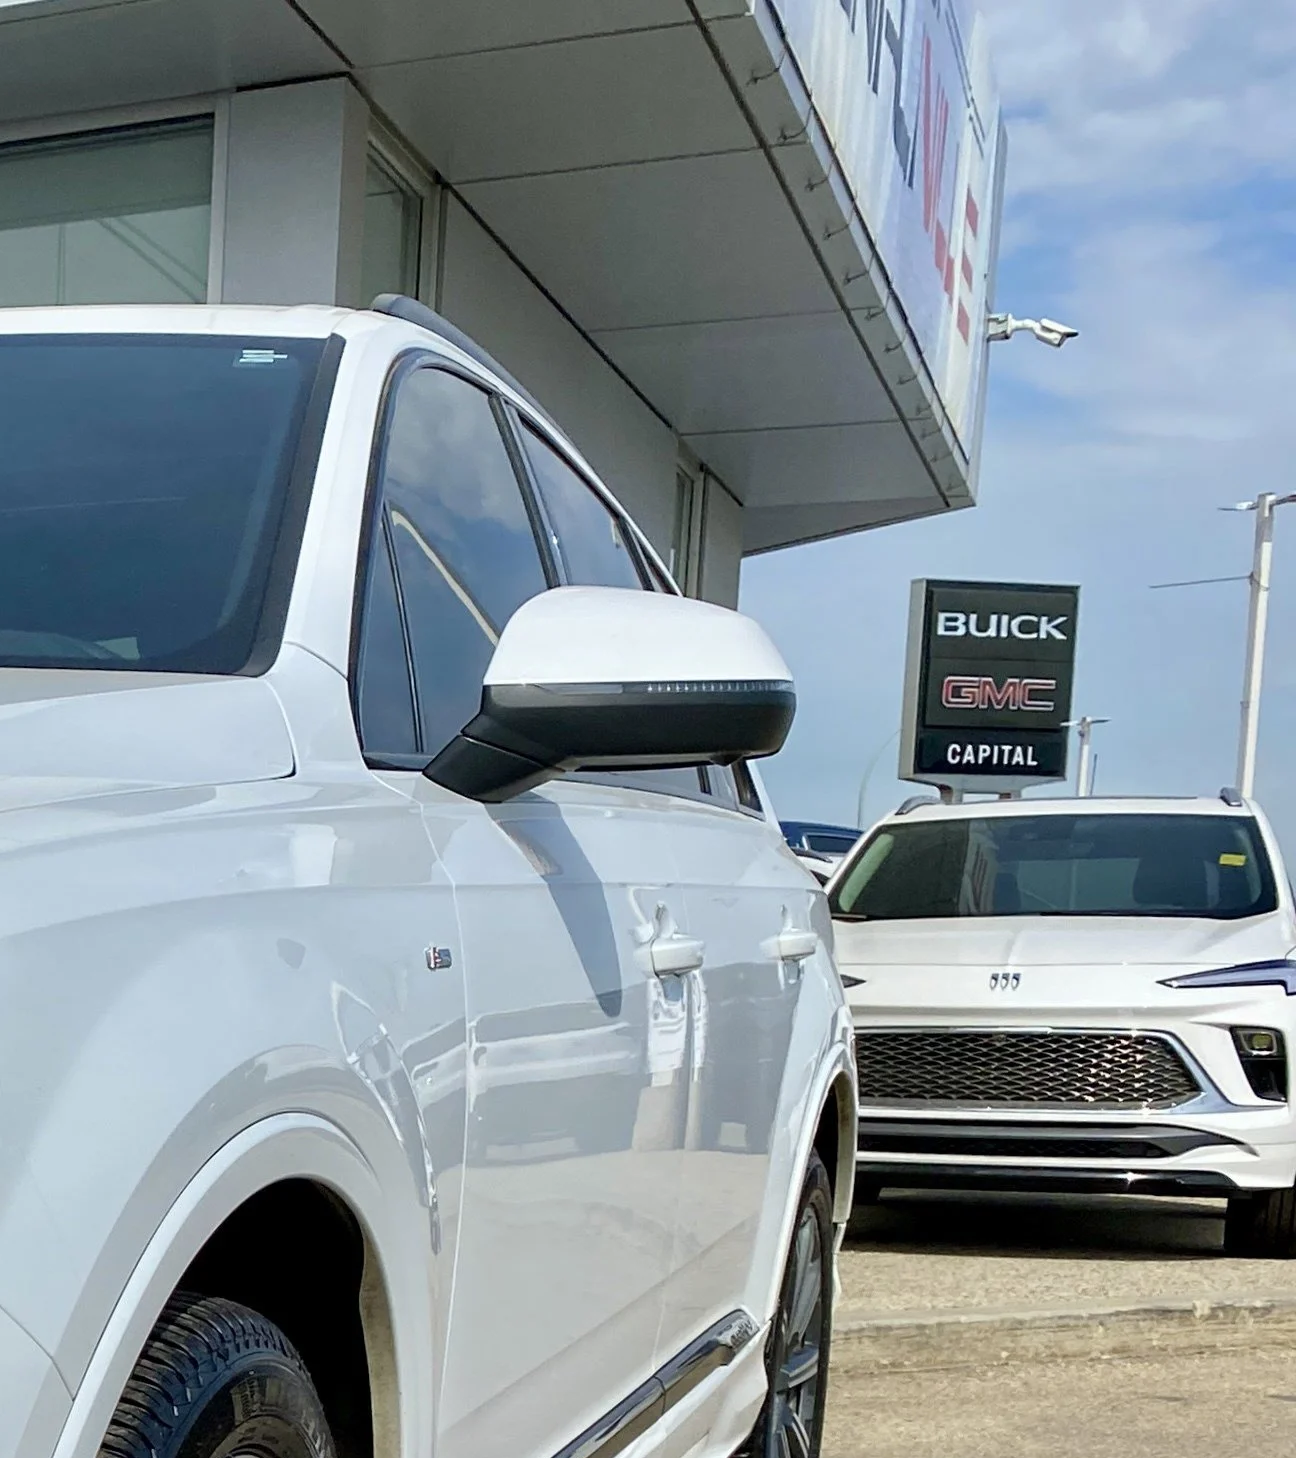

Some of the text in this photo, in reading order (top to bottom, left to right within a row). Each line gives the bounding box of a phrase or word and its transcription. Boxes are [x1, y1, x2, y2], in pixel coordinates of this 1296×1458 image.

[937, 611, 1068, 640] BUICK
[942, 675, 1056, 711] GMC
[946, 743, 1038, 766] CAPITAL
